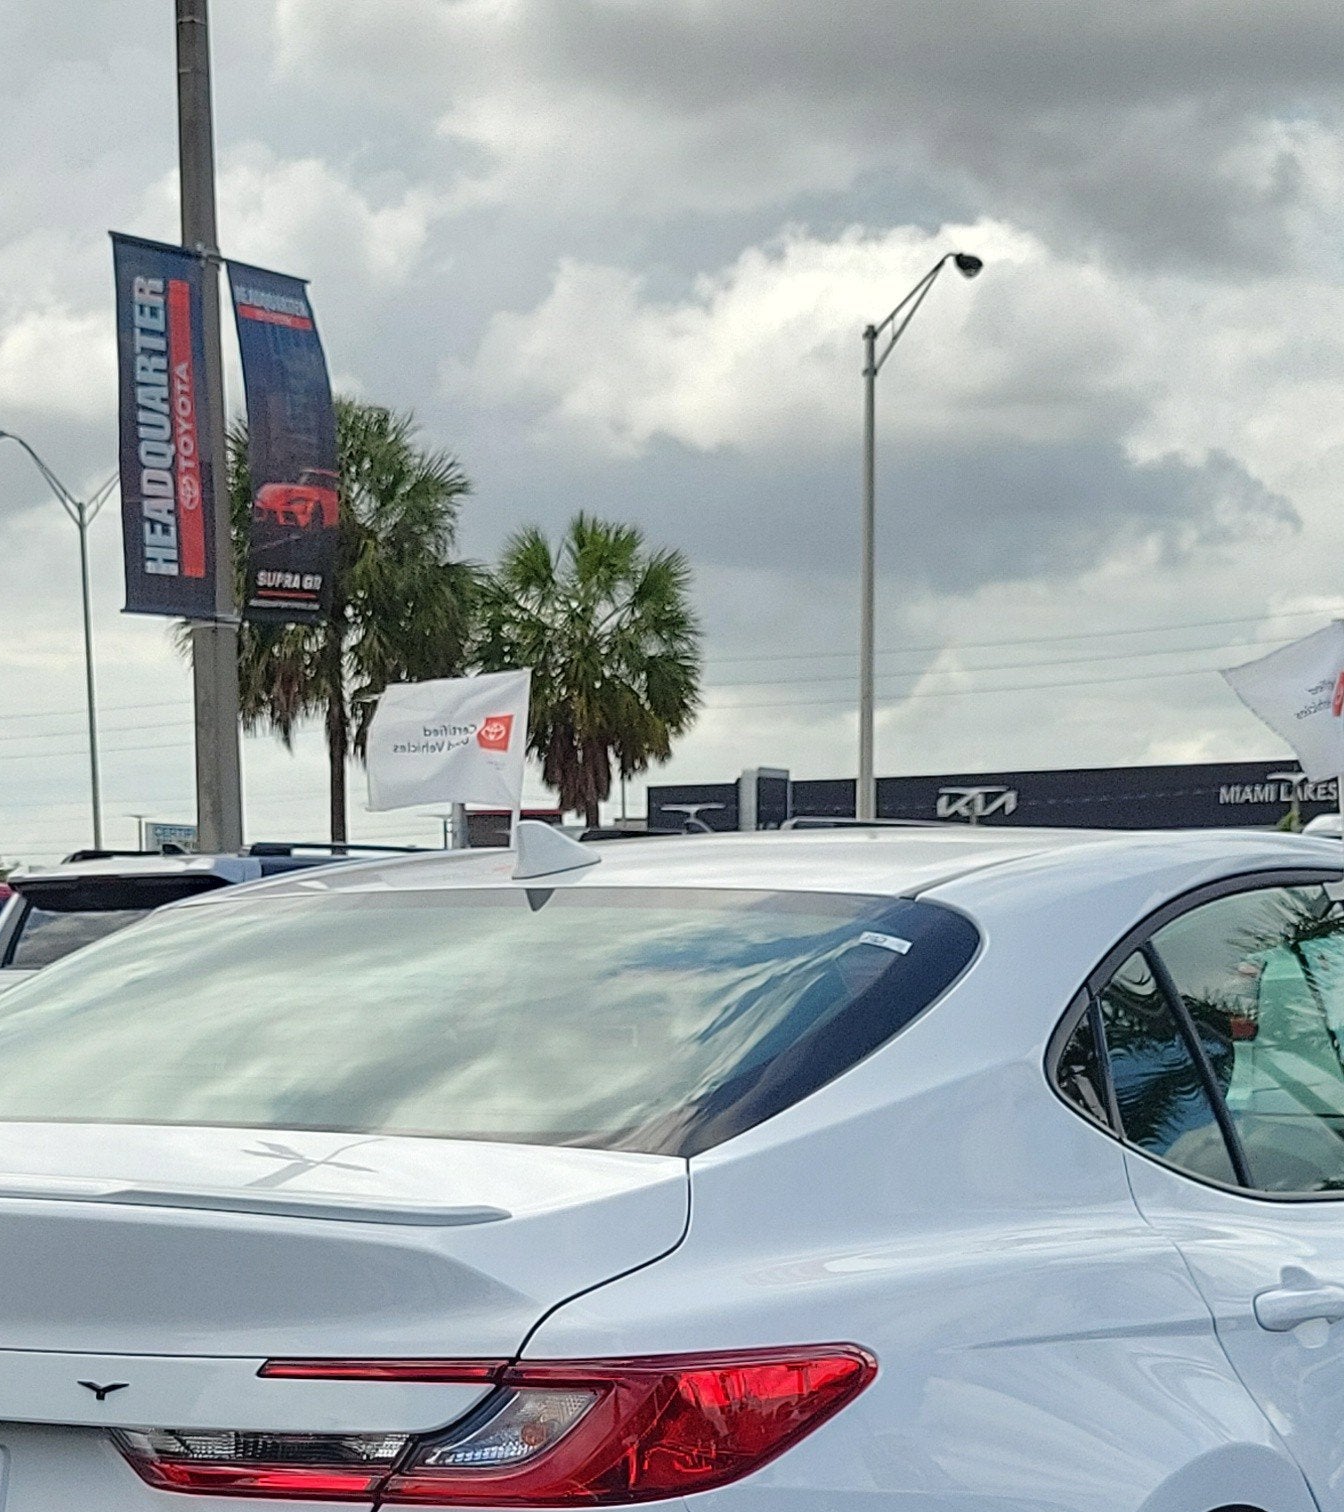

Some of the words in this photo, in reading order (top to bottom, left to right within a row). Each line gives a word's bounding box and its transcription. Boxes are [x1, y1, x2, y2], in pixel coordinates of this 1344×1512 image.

[134, 276, 179, 577] HEADQUARTER
[175, 361, 195, 470] TOYOTA
[256, 570, 301, 589] SUPRA
[937, 785, 1018, 818] KIA
[1219, 784, 1279, 804] MIAMI
